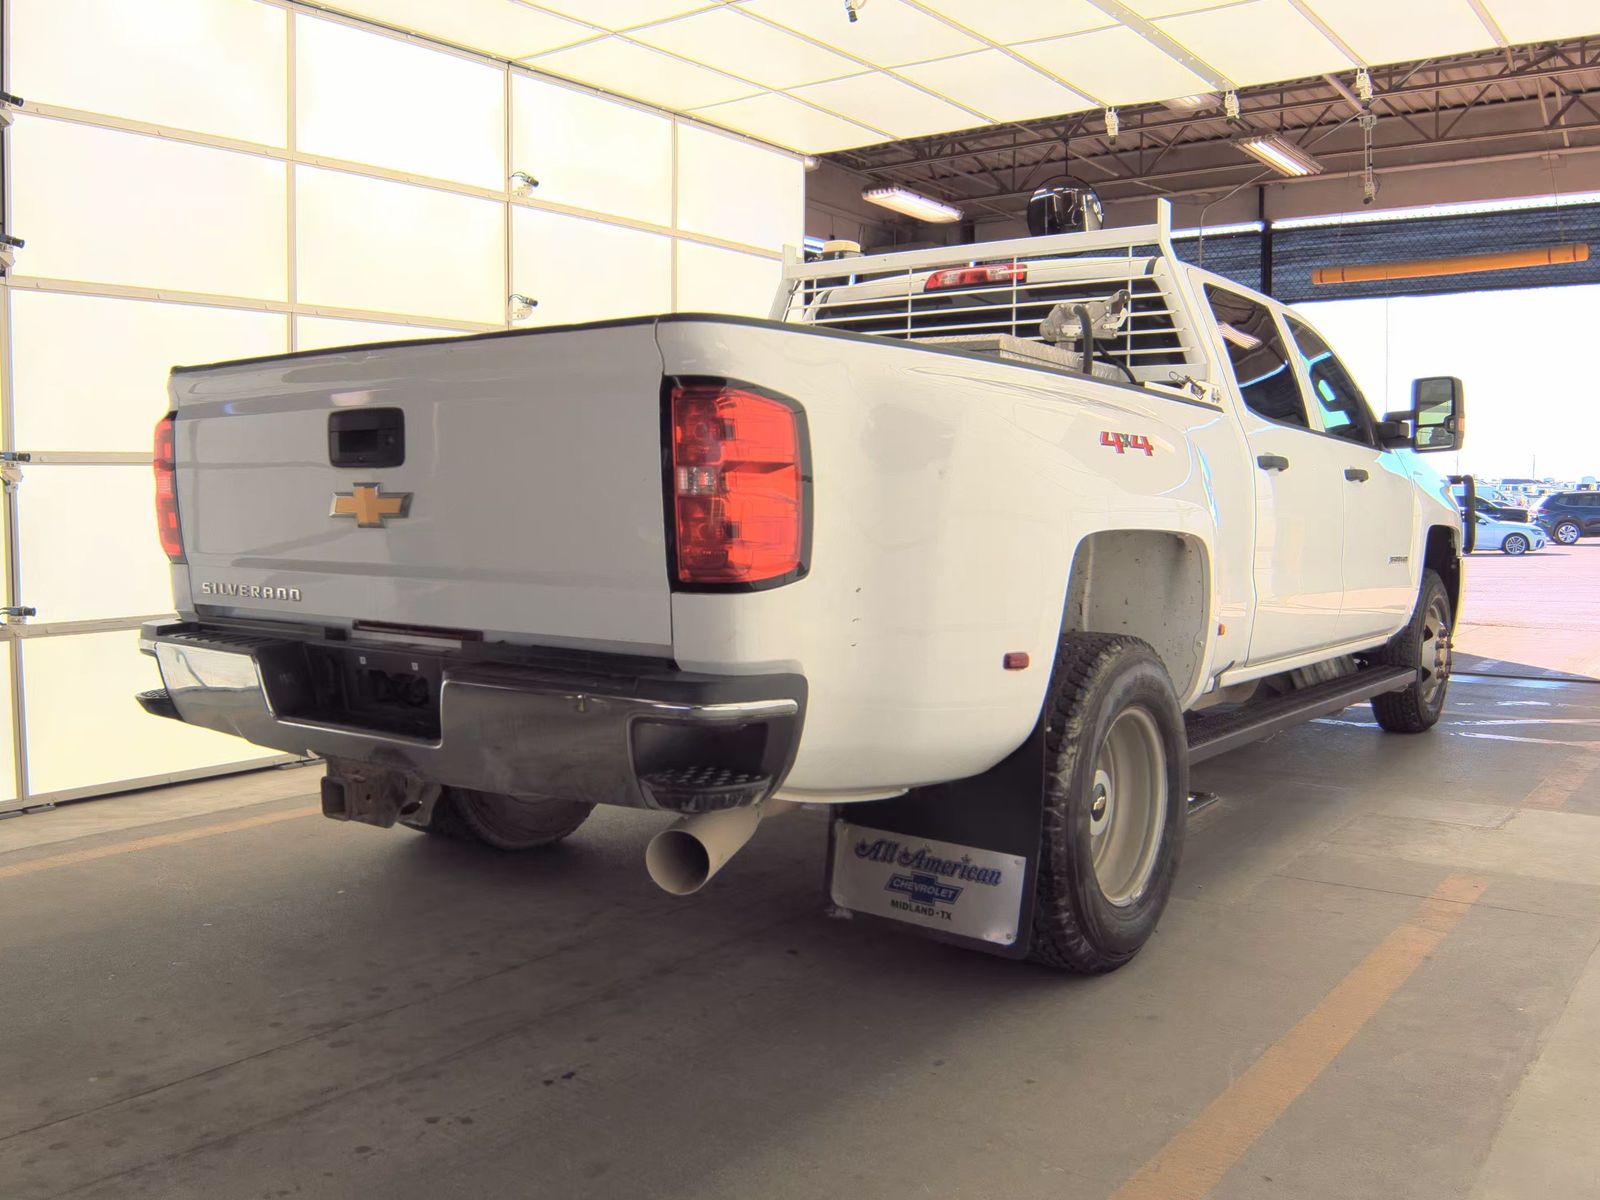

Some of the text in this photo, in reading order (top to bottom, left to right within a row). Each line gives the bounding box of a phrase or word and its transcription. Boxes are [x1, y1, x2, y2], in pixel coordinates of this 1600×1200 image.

[202, 582, 301, 601] SILVERADO
[854, 838, 1001, 886] All American
[892, 877, 954, 899] CHEVROLET
